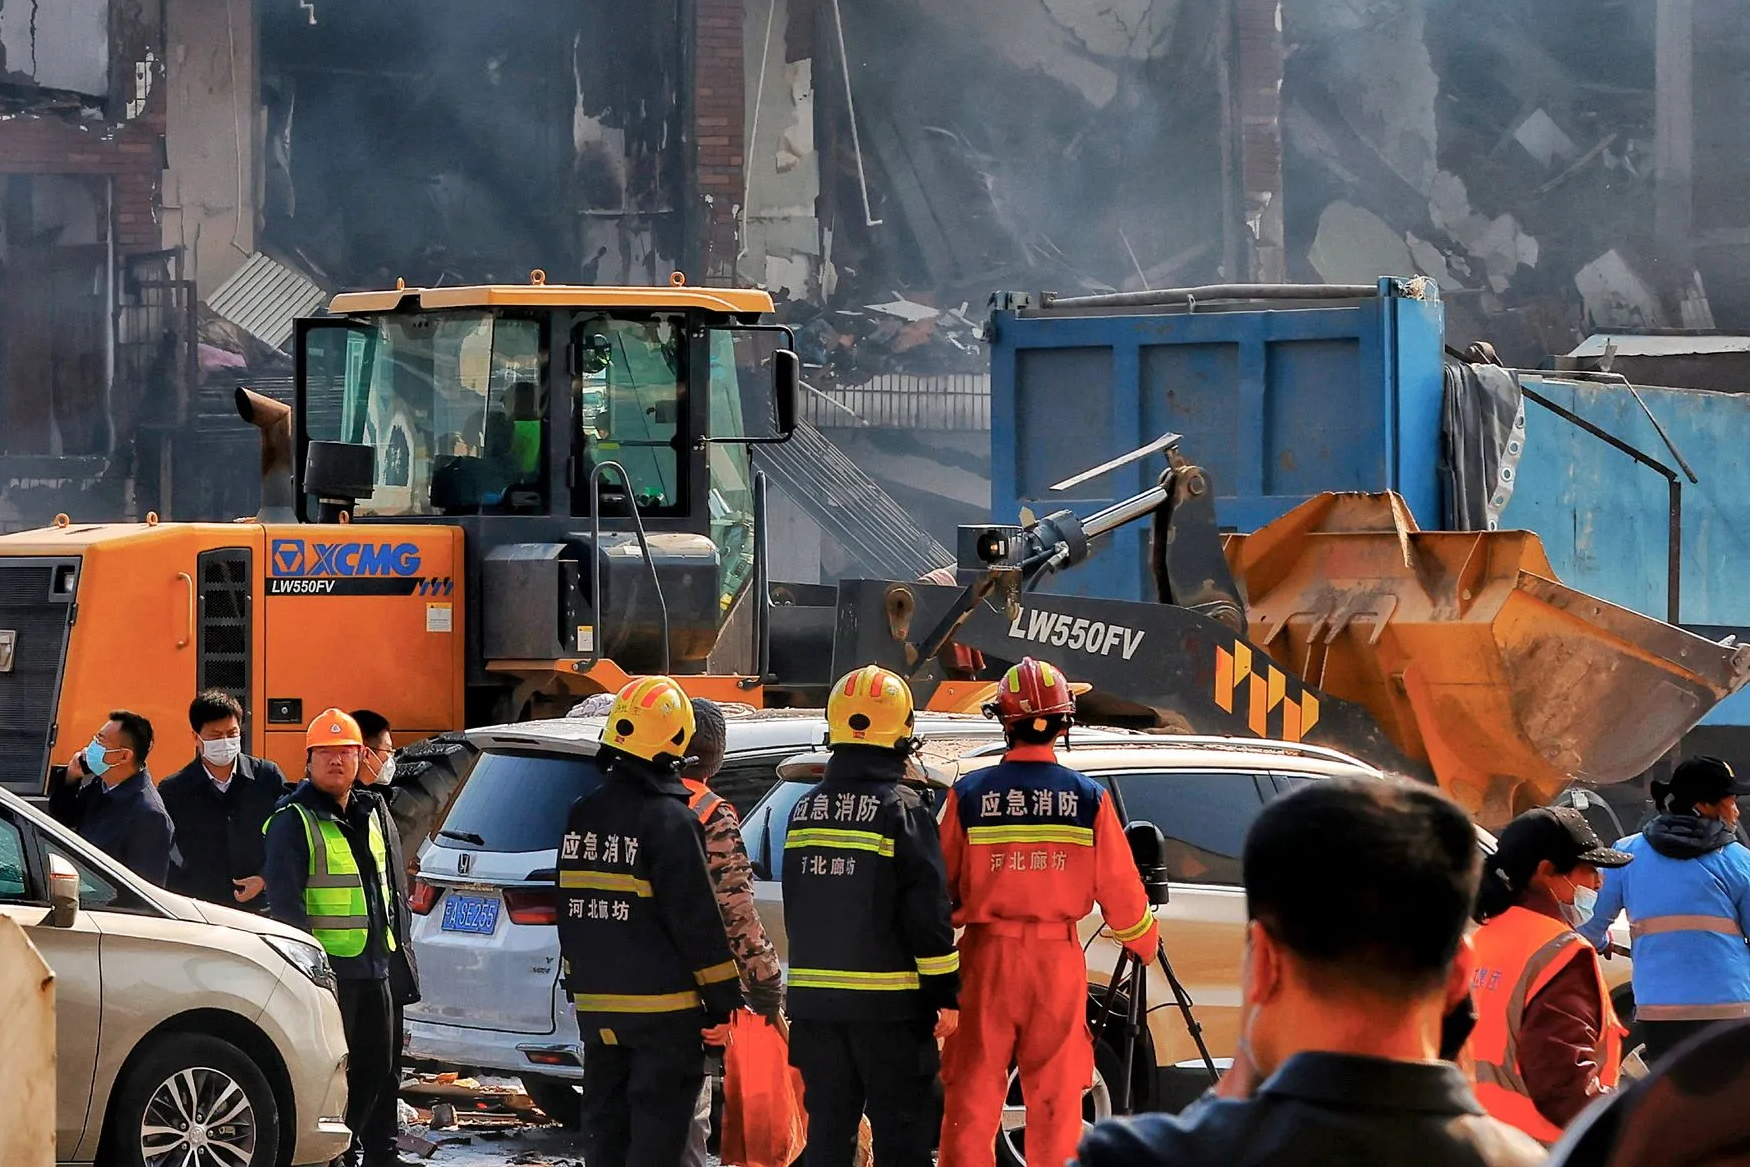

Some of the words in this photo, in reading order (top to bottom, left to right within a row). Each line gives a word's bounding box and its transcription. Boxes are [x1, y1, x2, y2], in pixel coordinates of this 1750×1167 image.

[306, 543, 421, 576] XCMG
[271, 580, 335, 593] LW550FV
[1008, 606, 1145, 660] LW550FV
[793, 793, 880, 822] 应急消防
[980, 789, 1079, 817] 应急消防
[561, 831, 639, 866] 应急消防
[991, 851, 1067, 872] 河北廊坊
[568, 898, 629, 921] 河北廊坊
